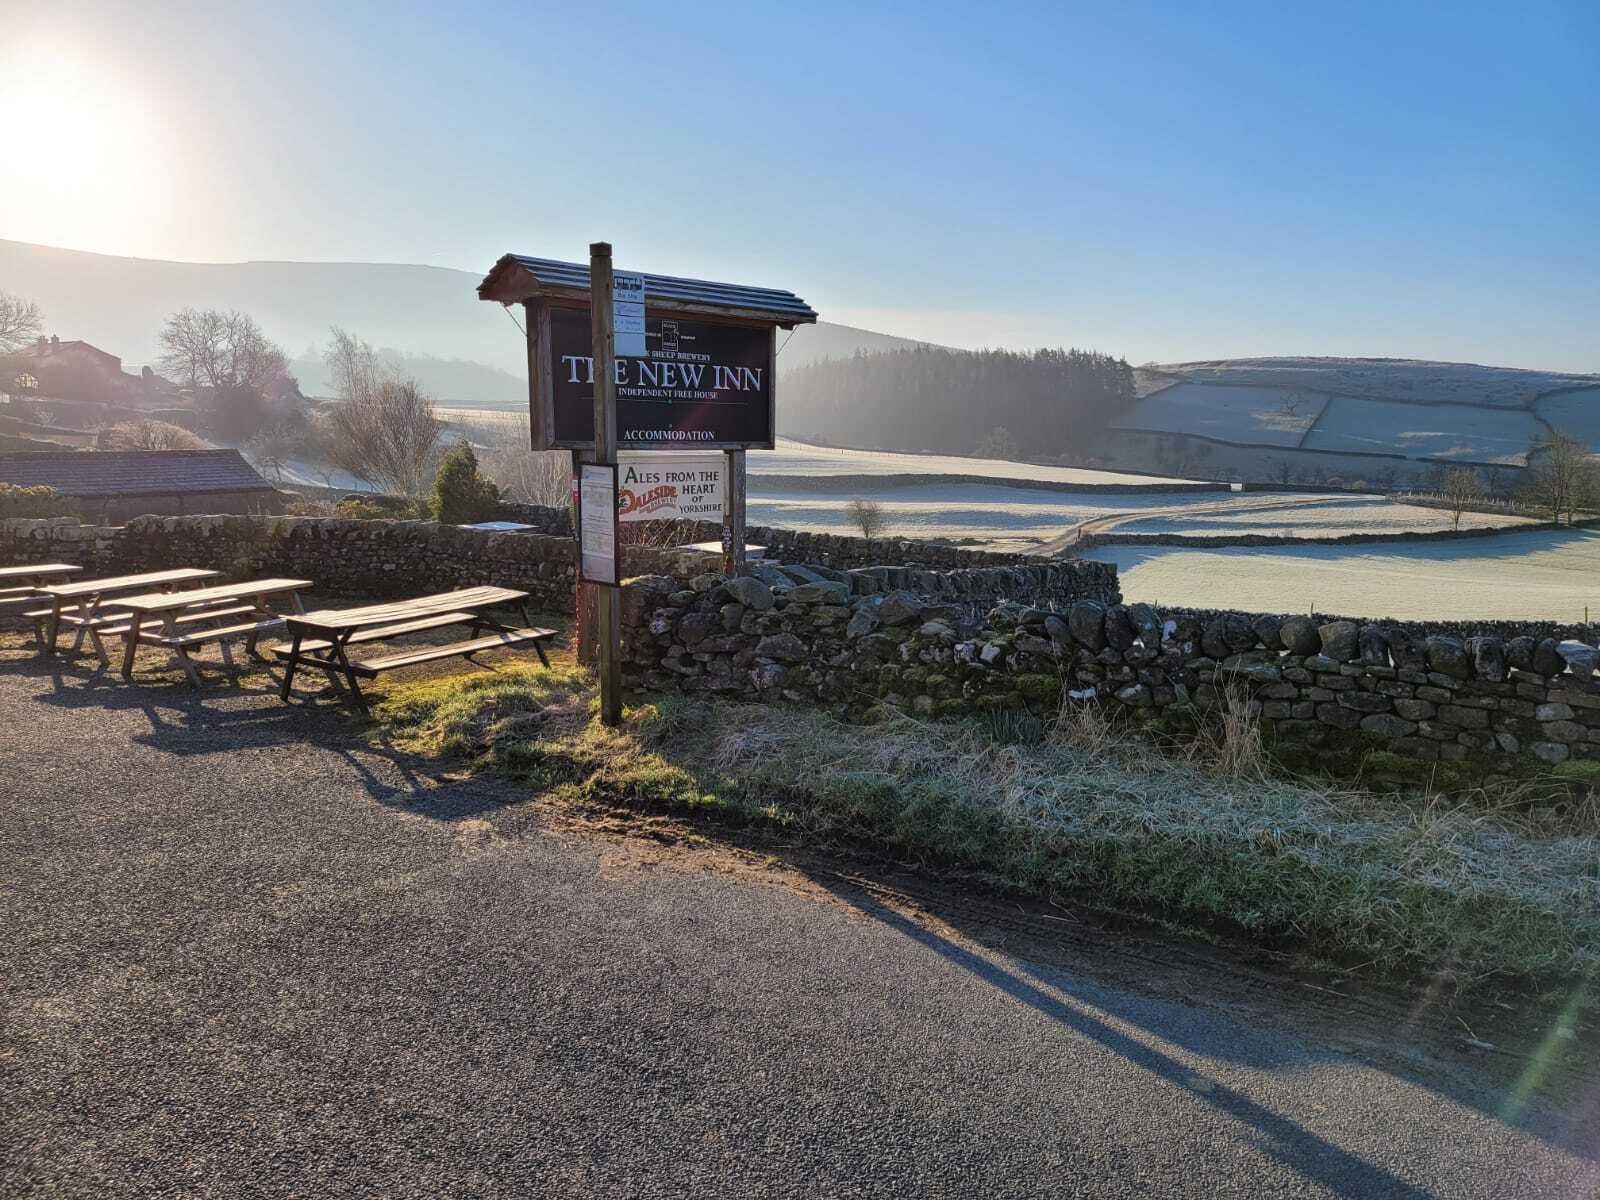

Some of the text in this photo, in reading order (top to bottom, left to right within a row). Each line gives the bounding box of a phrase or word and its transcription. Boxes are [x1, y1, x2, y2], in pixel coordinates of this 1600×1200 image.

[636, 360, 706, 389] NEW
[712, 365, 763, 391] INN
[618, 387, 718, 400] INDEPENDENT FREE HOUSE
[624, 430, 715, 441] ACCOMMODATION
[665, 472, 695, 482] FROM
[699, 471, 719, 481] THE
[682, 484, 715, 495] HEART
[691, 495, 704, 503] OF
[679, 503, 722, 514] YORKSHIRE
